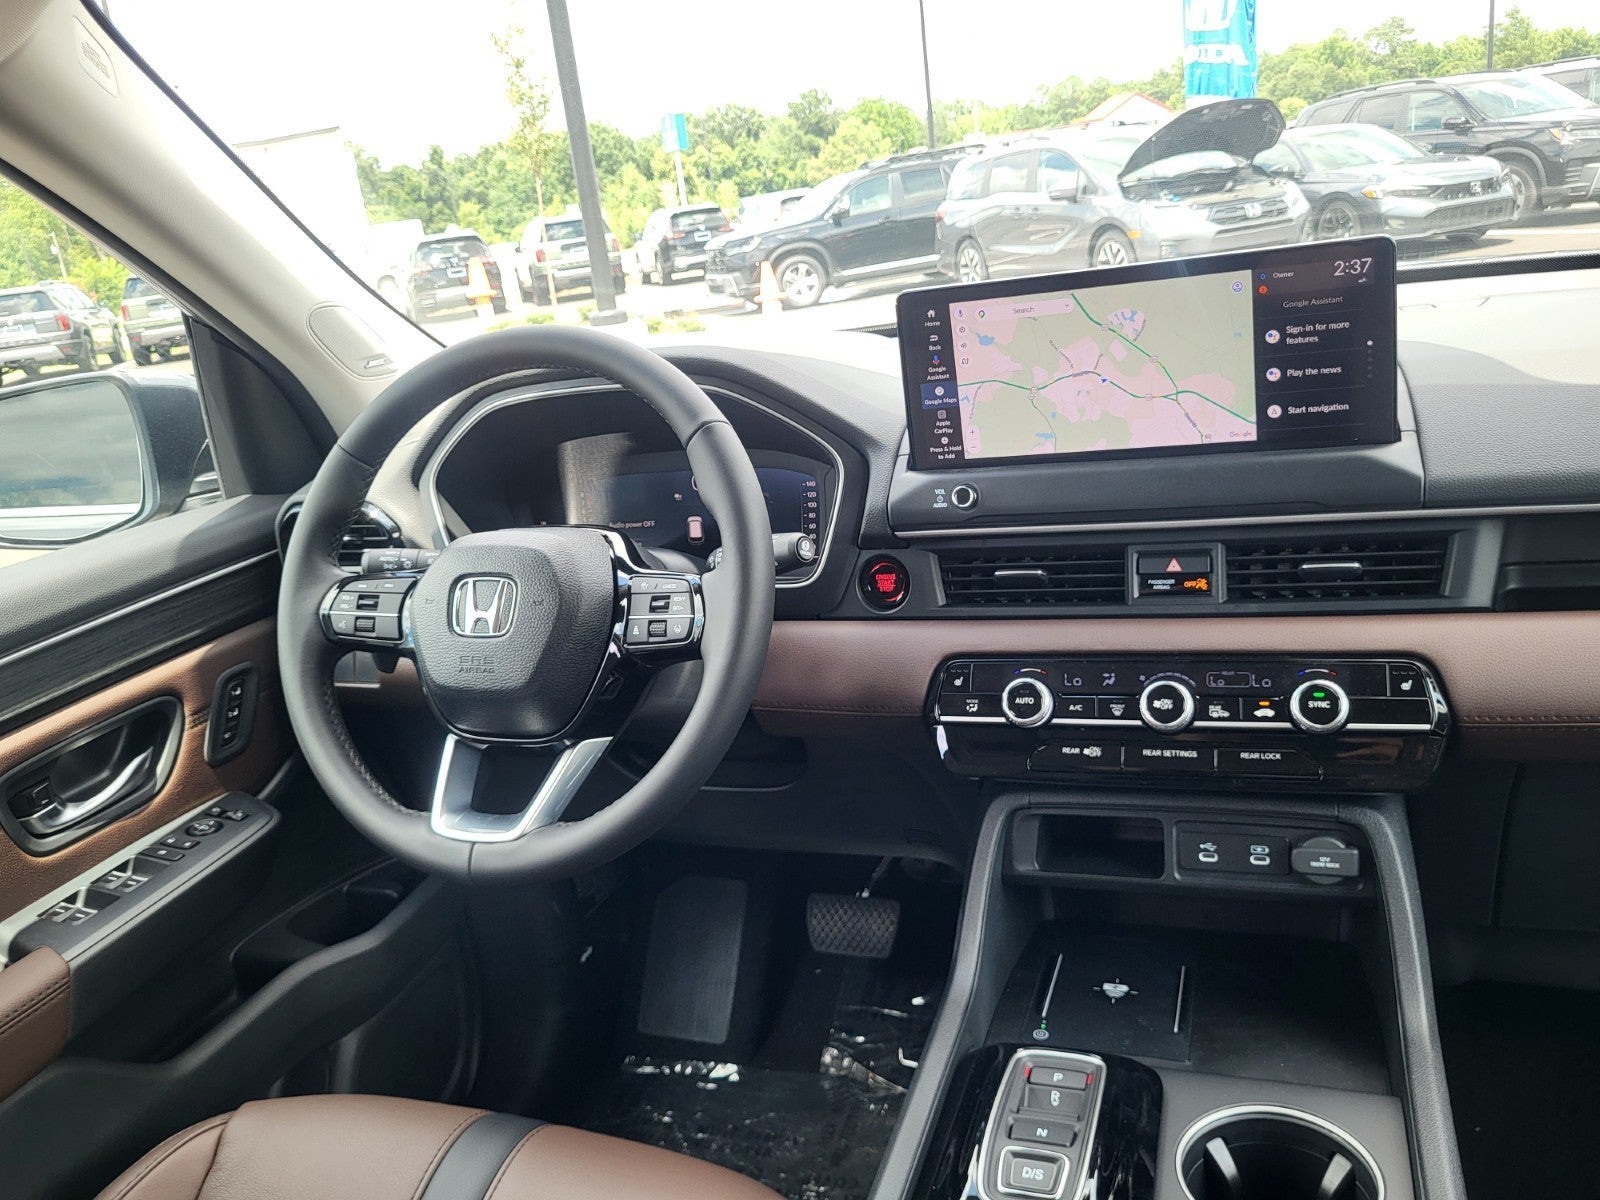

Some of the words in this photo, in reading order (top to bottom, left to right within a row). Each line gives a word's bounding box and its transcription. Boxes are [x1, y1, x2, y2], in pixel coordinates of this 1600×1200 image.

[1333, 257, 1372, 276] 2:37
[1283, 299, 1309, 308] Google
[1310, 296, 1344, 306] Assistant
[1286, 324, 1314, 335] Sign-in
[1315, 322, 1326, 330] for
[1328, 321, 1350, 330] more
[1286, 335, 1318, 345] features
[1286, 368, 1304, 378] Play
[1305, 367, 1318, 375] the
[1320, 366, 1342, 374] news
[1288, 406, 1306, 414] Start
[1308, 402, 1350, 413] navigation
[643, 520, 656, 528] OFF
[1064, 673, 1082, 686] Lo
[1252, 674, 1272, 688] Lo
[1014, 697, 1035, 705] AUTO
[1308, 700, 1331, 709] SYNC
[1062, 746, 1081, 754] REAR
[1142, 748, 1162, 757] REAR
[1162, 750, 1198, 758] SETTINGS
[1240, 752, 1260, 760] REAR
[1260, 752, 1282, 760] LOCK
[1053, 1072, 1064, 1082] P
[1036, 1127, 1049, 1138] N
[1022, 1166, 1045, 1181] D/S
